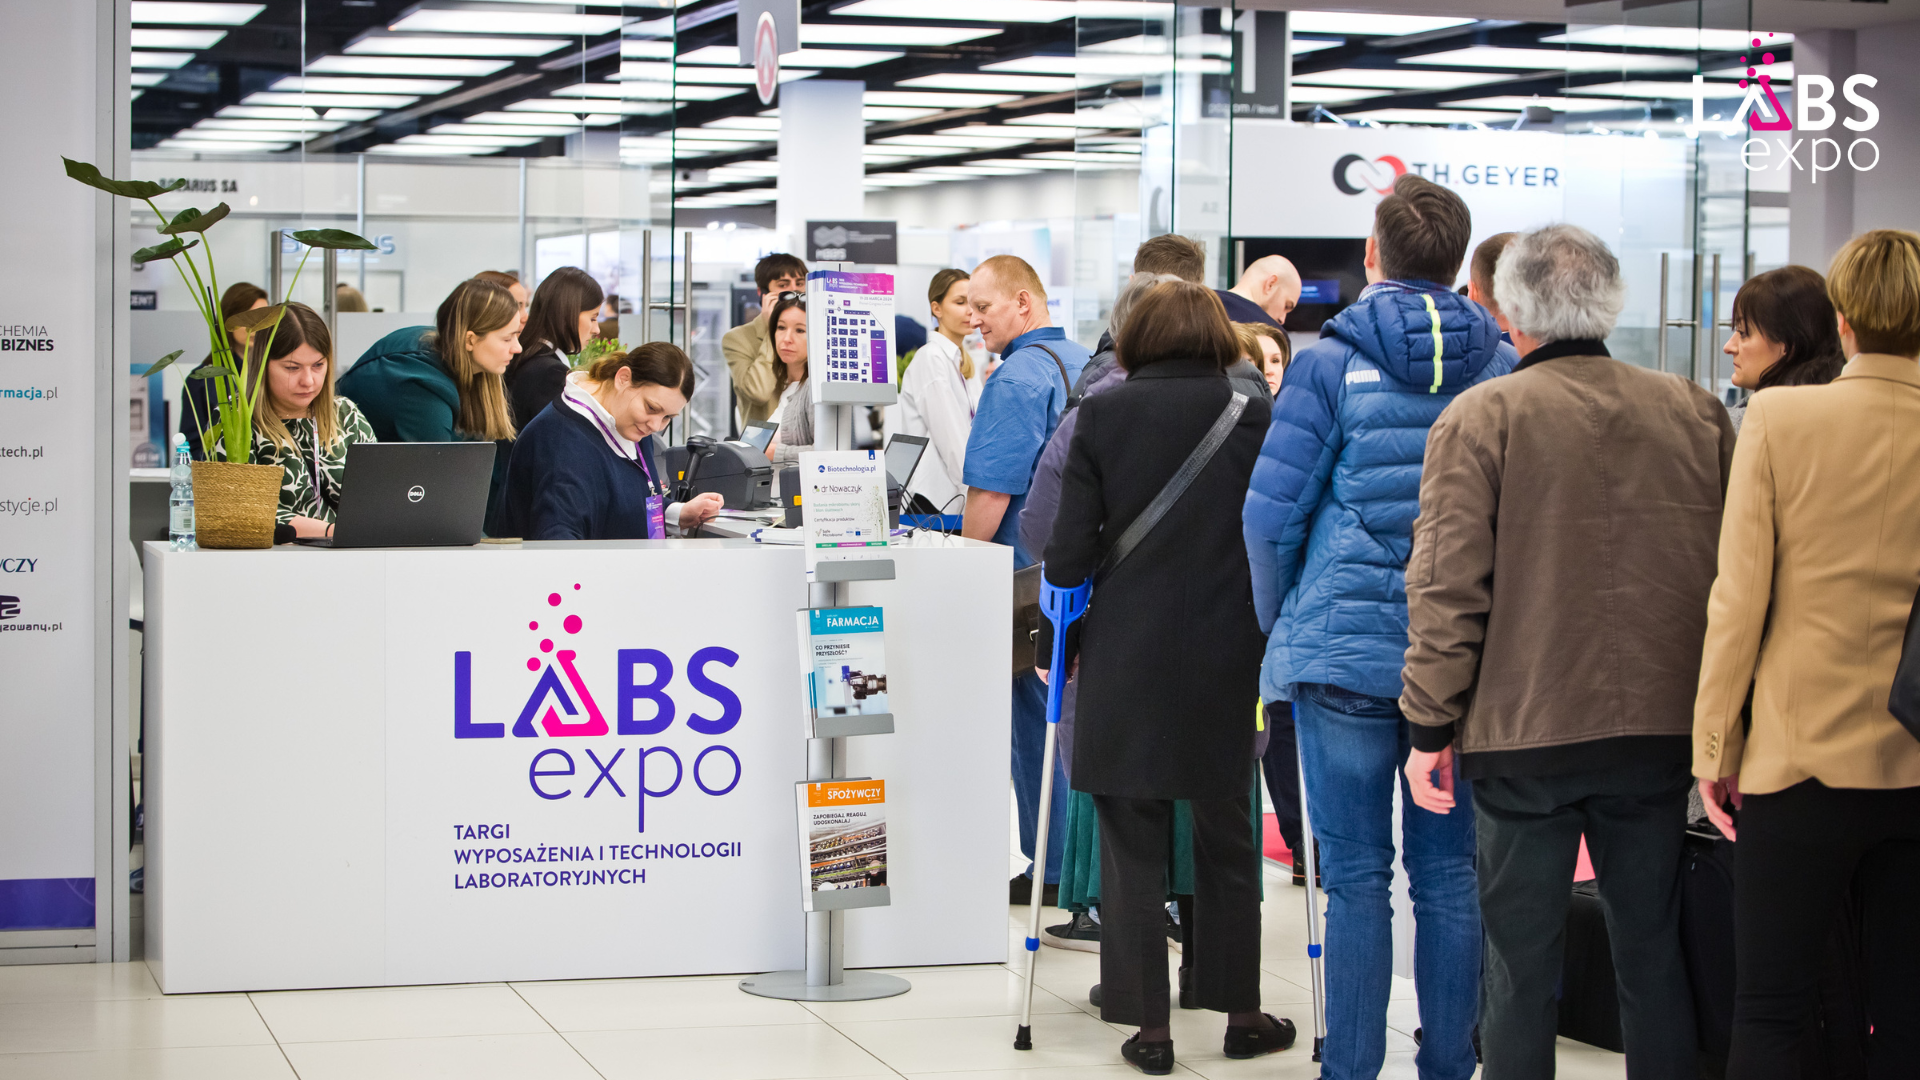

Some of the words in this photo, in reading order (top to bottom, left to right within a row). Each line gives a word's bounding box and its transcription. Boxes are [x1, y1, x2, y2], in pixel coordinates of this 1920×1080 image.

[0, 325, 48, 337] HEMIA
[1, 339, 54, 351] BIZNES
[0, 445, 43, 460] tech.pl
[827, 616, 879, 627] FARMACJA
[454, 646, 742, 739] LABS
[529, 744, 742, 833] expo
[828, 788, 881, 800] SPOŻYWCZY
[453, 823, 510, 840] TARGI
[454, 843, 594, 864] WYPOSAŻENIA
[599, 846, 604, 860] I
[609, 841, 742, 860] TECHNOLOGII
[454, 868, 646, 889] LABORATORYJNYCH
